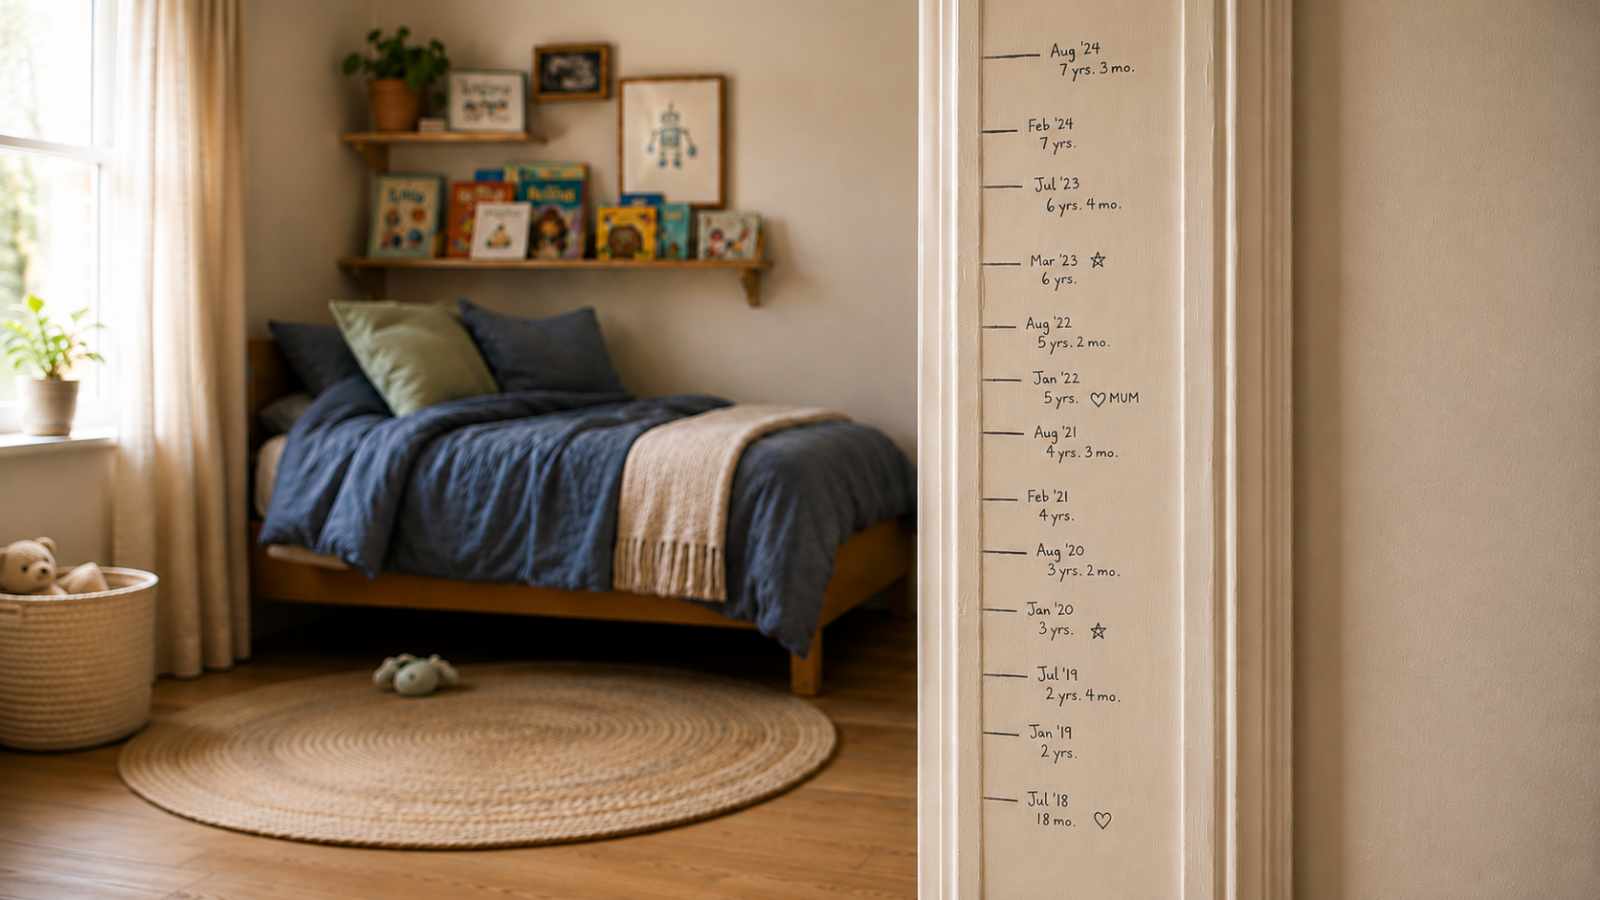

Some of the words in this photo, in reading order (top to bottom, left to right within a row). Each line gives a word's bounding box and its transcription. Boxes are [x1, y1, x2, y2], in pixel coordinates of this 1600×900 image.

[1049, 42, 1076, 63] Aug
[1080, 40, 1101, 56] '24
[1059, 62, 1068, 77] 7
[1071, 66, 1096, 83] yrs.
[1099, 61, 1109, 75] 3
[1111, 64, 1135, 74] mo.
[1028, 117, 1051, 133] Feb
[1054, 116, 1074, 131] '24
[1039, 136, 1049, 150] 7
[1052, 139, 1077, 156] yrs.
[1033, 176, 1057, 193] Jul
[1059, 176, 1080, 191] '23
[1046, 197, 1056, 213] 6
[1058, 202, 1083, 218] yrs.
[1085, 197, 1096, 211] 4
[1098, 201, 1122, 211] mo.
[1030, 253, 1056, 268] Mar
[1059, 253, 1079, 267] '23
[1041, 271, 1051, 286] 6
[1053, 275, 1078, 292] yrs.
[1025, 316, 1050, 336] Aug
[1053, 315, 1073, 330] '22
[1037, 334, 1047, 349] 5
[1049, 339, 1073, 356] yrs.
[1076, 335, 1085, 348] 2
[1087, 339, 1111, 348] mo.
[1032, 370, 1058, 386] Jan
[1060, 370, 1081, 385] '22
[1043, 390, 1053, 405] 5
[1055, 395, 1079, 411] yrs.
[1109, 391, 1140, 404] MUM
[1033, 424, 1059, 445] Aug
[1061, 425, 1077, 439] '21
[1045, 444, 1056, 459] 4
[1057, 449, 1081, 464] yrs.
[1084, 445, 1093, 459] 3
[1095, 450, 1119, 458] mo.
[1027, 488, 1050, 503] Feb
[1053, 488, 1068, 503] '21
[1038, 507, 1049, 522] 4
[1050, 512, 1075, 527] yrs.
[1035, 542, 1062, 564] Aug
[1065, 542, 1085, 557] '20
[1047, 562, 1057, 577] 3
[1058, 567, 1083, 583] yrs.
[1086, 563, 1095, 577] 2
[1096, 568, 1121, 577] mo.
[1026, 600, 1051, 617] Jan
[1054, 601, 1074, 616] '20
[1038, 620, 1048, 635] 3
[1050, 626, 1074, 642] yrs.
[1036, 665, 1060, 683] Jul
[1062, 666, 1078, 682] '19
[1045, 686, 1055, 701] 2
[1057, 692, 1082, 708] yrs.
[1085, 688, 1095, 702] 4
[1097, 693, 1121, 703] mo.
[1028, 723, 1053, 740] Jan
[1056, 724, 1072, 740] '19
[1040, 743, 1050, 758] 2
[1052, 749, 1078, 765] yrs.
[1026, 790, 1050, 808] Jul
[1052, 792, 1069, 808] '18
[1037, 812, 1050, 827] 18
[1053, 818, 1076, 828] mo.
